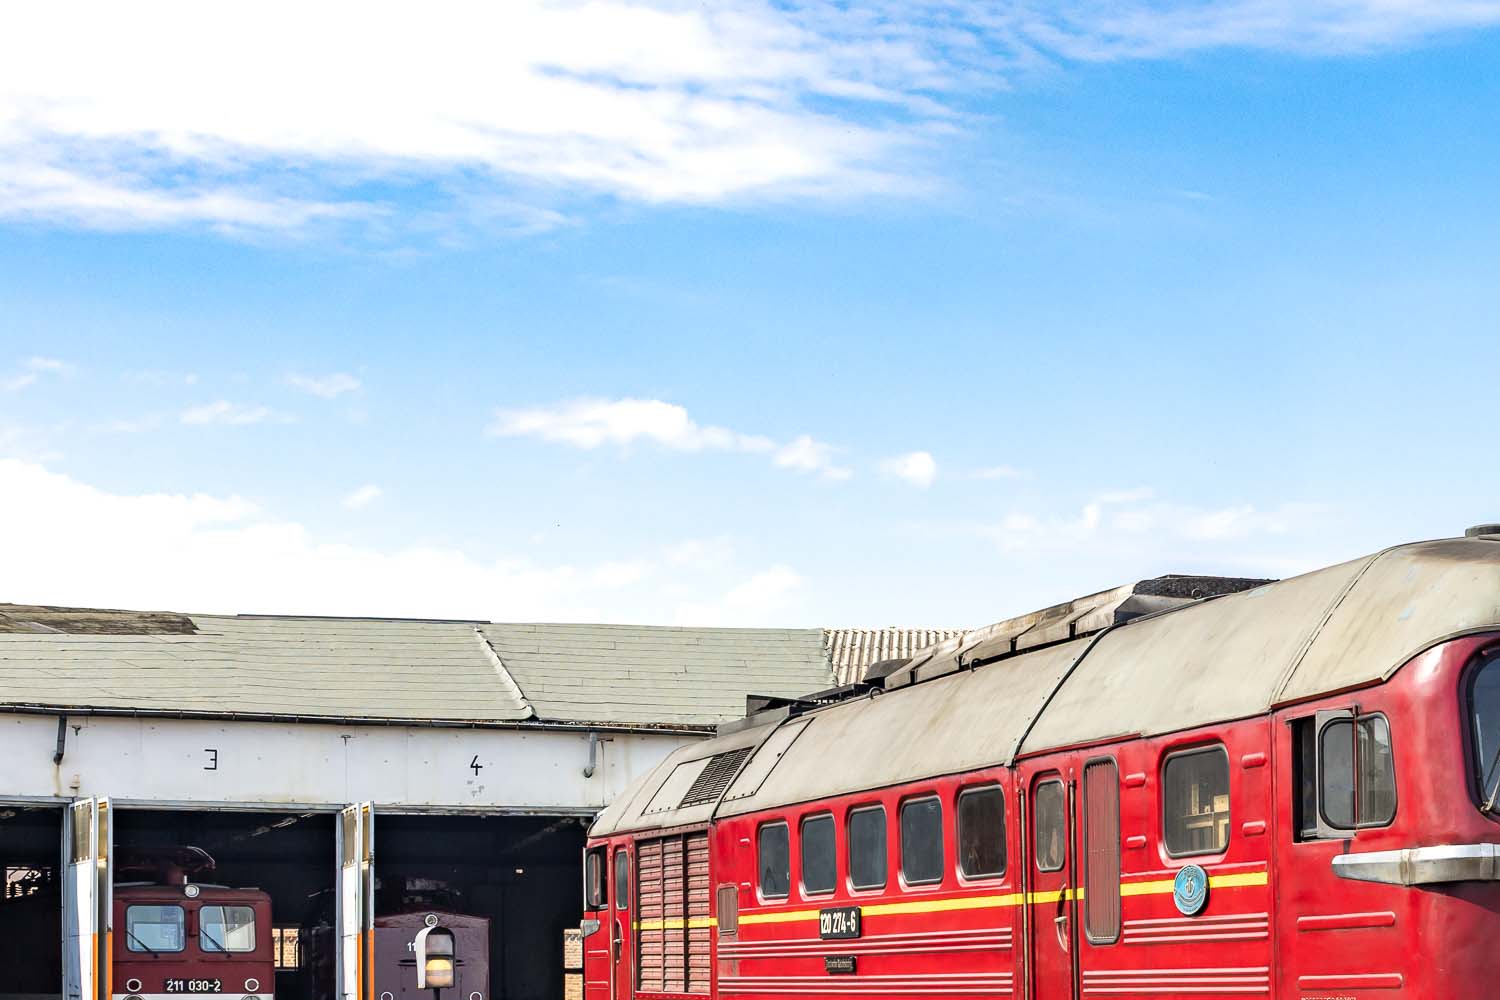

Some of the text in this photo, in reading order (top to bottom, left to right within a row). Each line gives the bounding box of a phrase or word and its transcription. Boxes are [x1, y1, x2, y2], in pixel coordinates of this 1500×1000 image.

[203, 748, 218, 770] 3
[470, 754, 483, 776] 4
[820, 910, 856, 934] 120 274-6
[166, 980, 221, 991] 211 030-2
